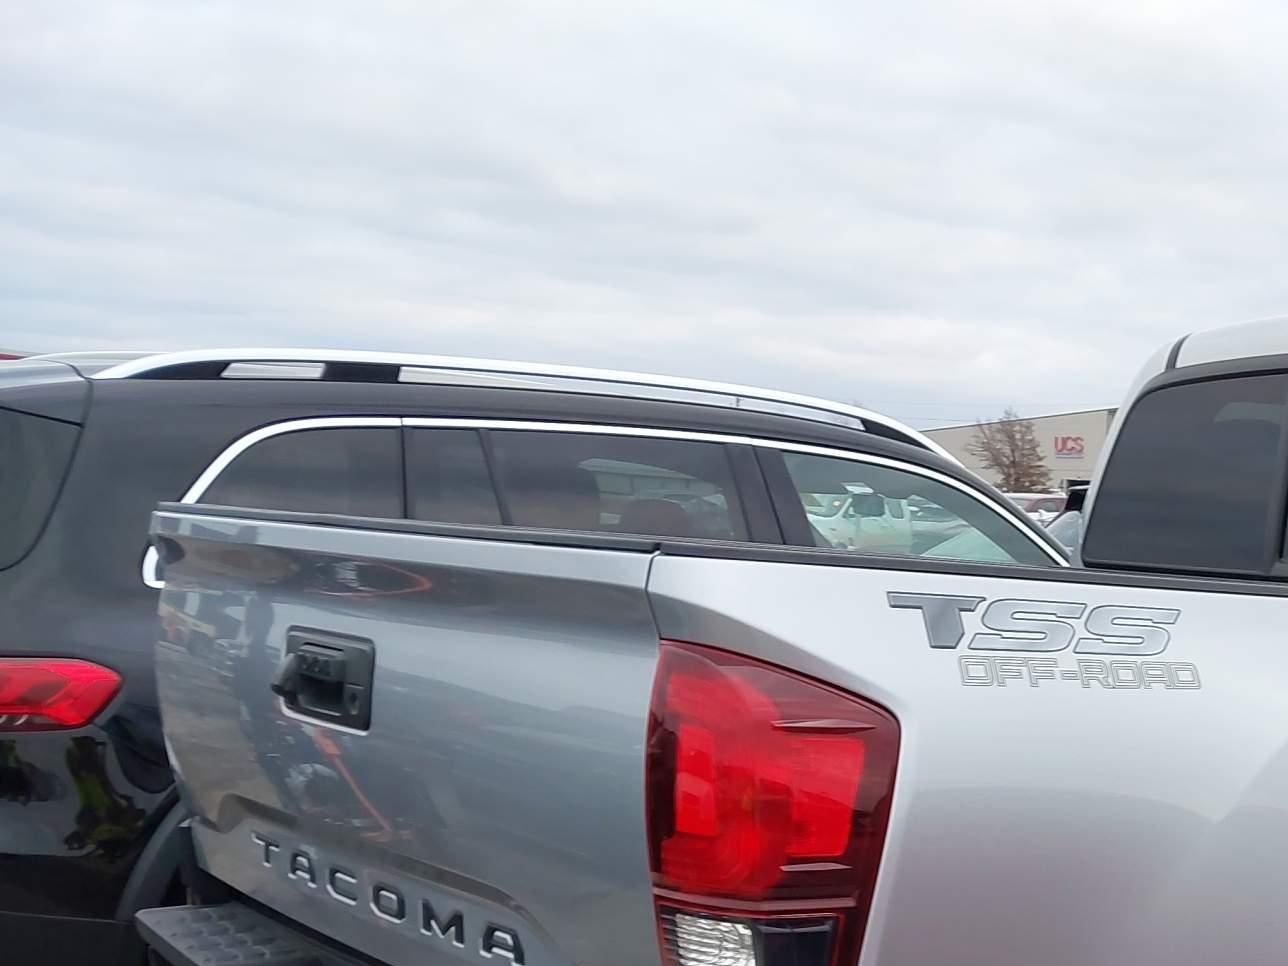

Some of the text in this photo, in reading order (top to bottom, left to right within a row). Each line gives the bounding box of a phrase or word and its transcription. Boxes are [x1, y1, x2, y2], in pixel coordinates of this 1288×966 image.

[1054, 436, 1085, 453] UCS
[886, 591, 1182, 657] TSS
[958, 655, 1202, 690] OFF-ROAD
